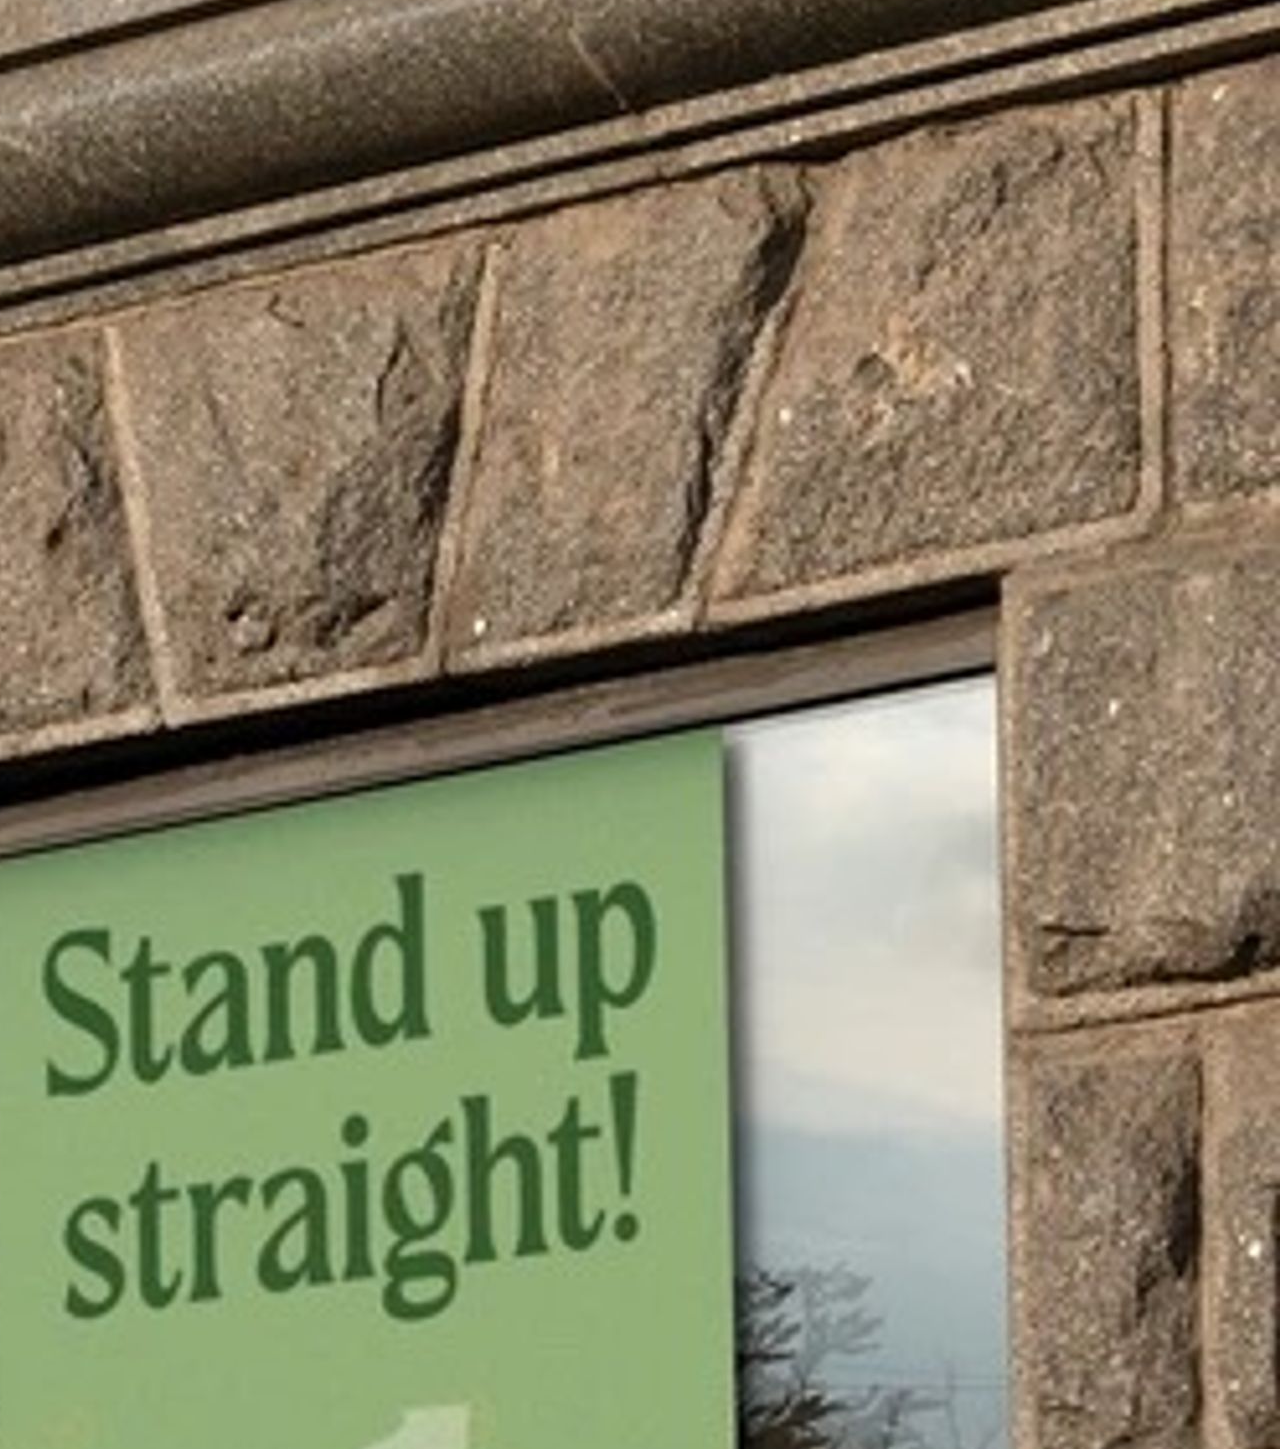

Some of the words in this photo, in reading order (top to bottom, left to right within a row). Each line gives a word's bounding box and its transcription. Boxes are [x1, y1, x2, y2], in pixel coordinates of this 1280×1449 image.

[41, 871, 432, 1098] Stand
[476, 881, 657, 1062] up
[62, 1069, 640, 1323] straight!
